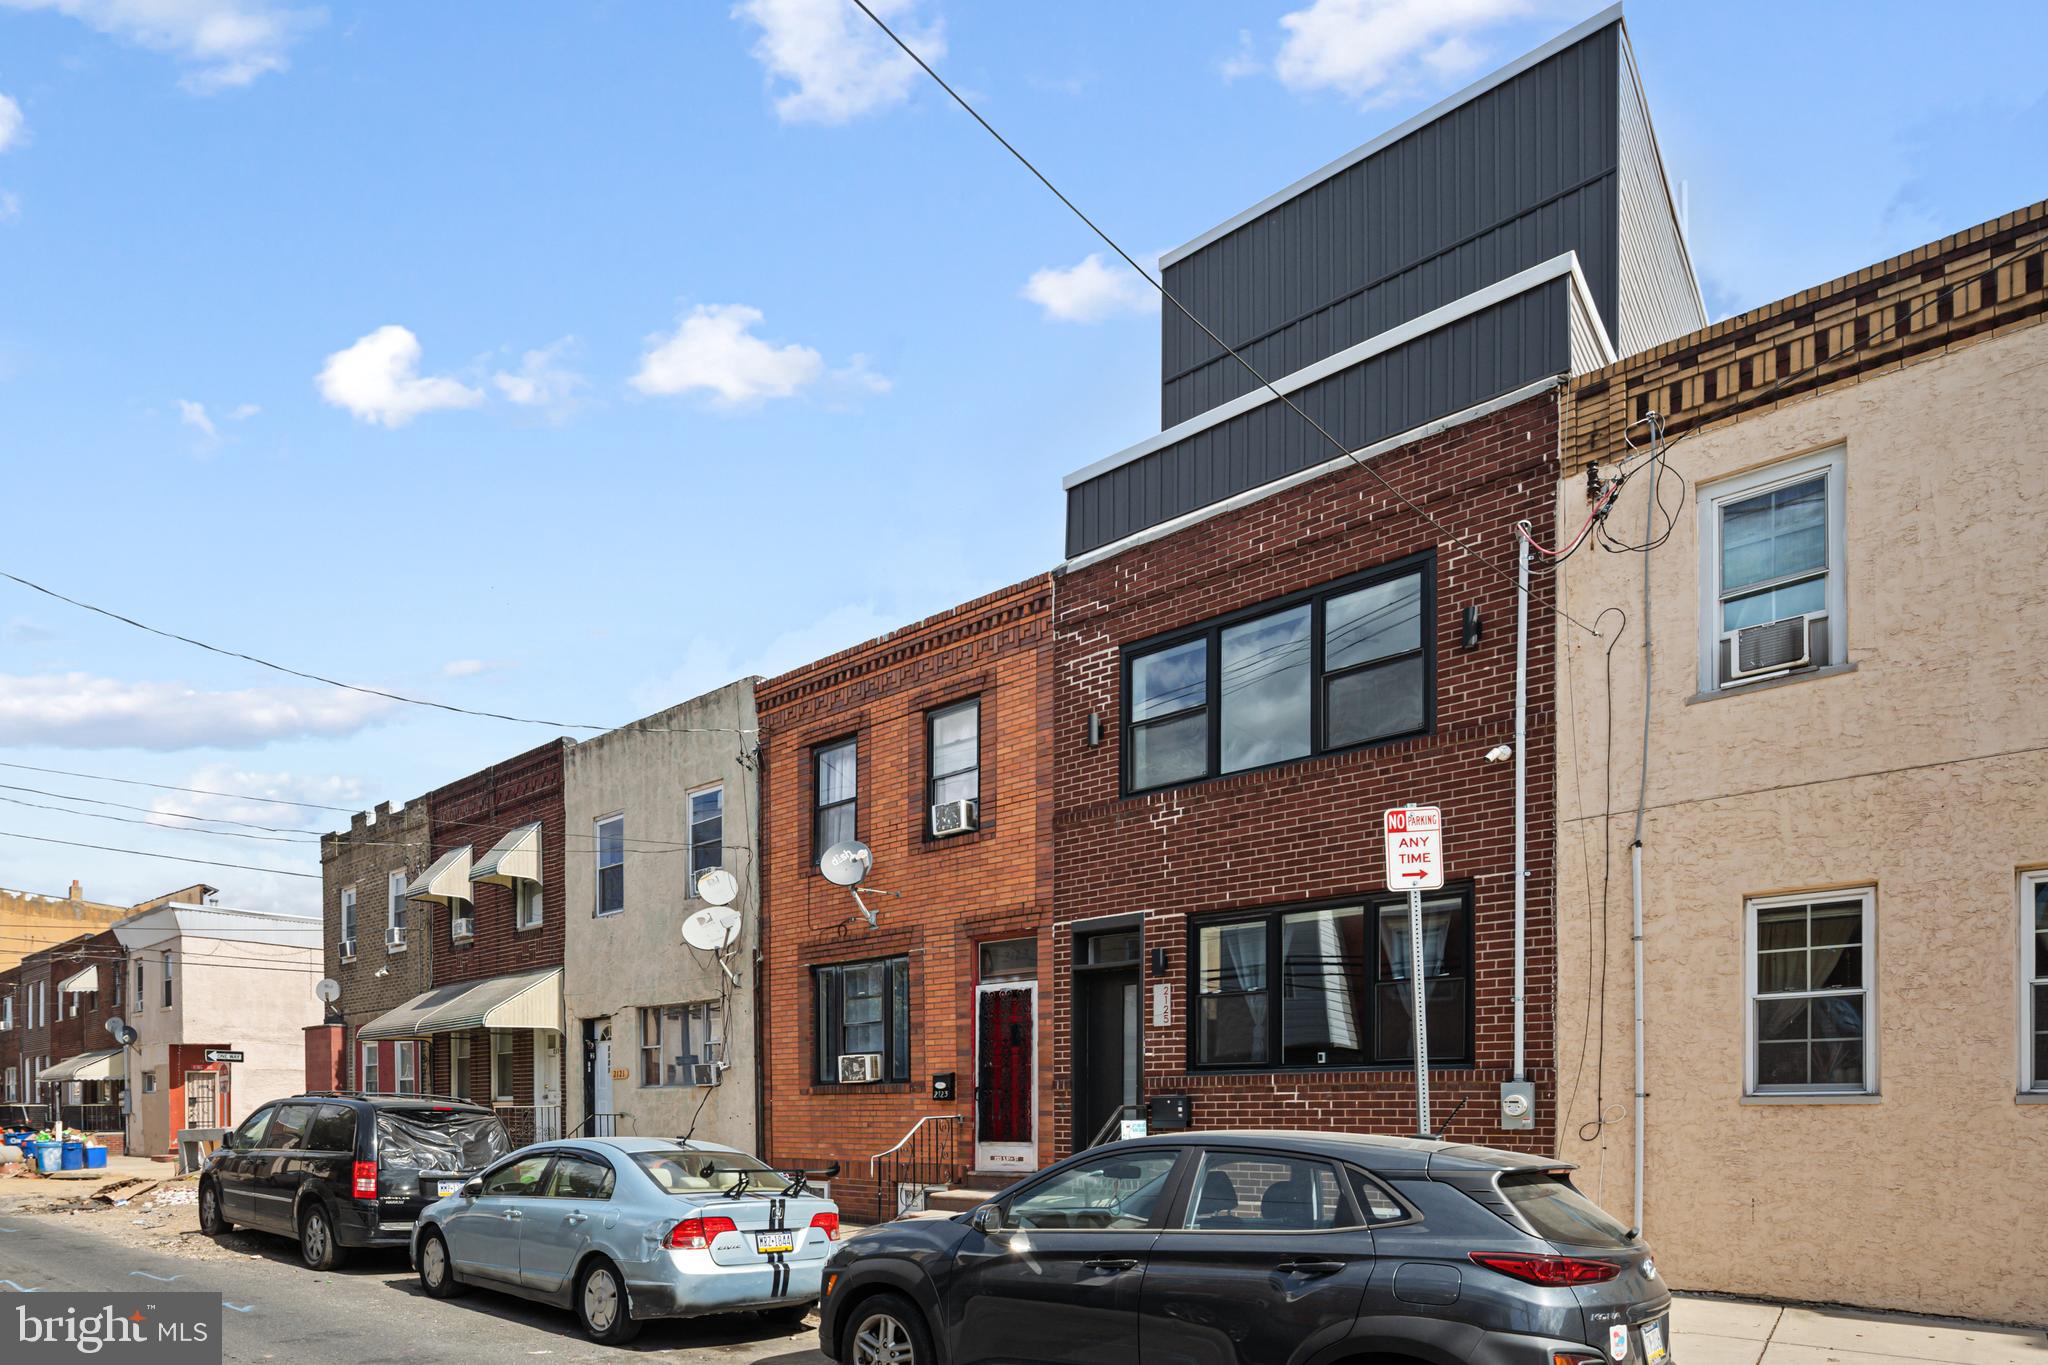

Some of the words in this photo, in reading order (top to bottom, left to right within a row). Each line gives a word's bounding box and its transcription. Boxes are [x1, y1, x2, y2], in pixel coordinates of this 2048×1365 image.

[1388, 813, 1405, 829] NO
[1407, 814, 1437, 826] PARKING
[1399, 837, 1429, 848] ANY
[1399, 853, 1431, 864] TIME
[933, 1090, 949, 1099] 2123
